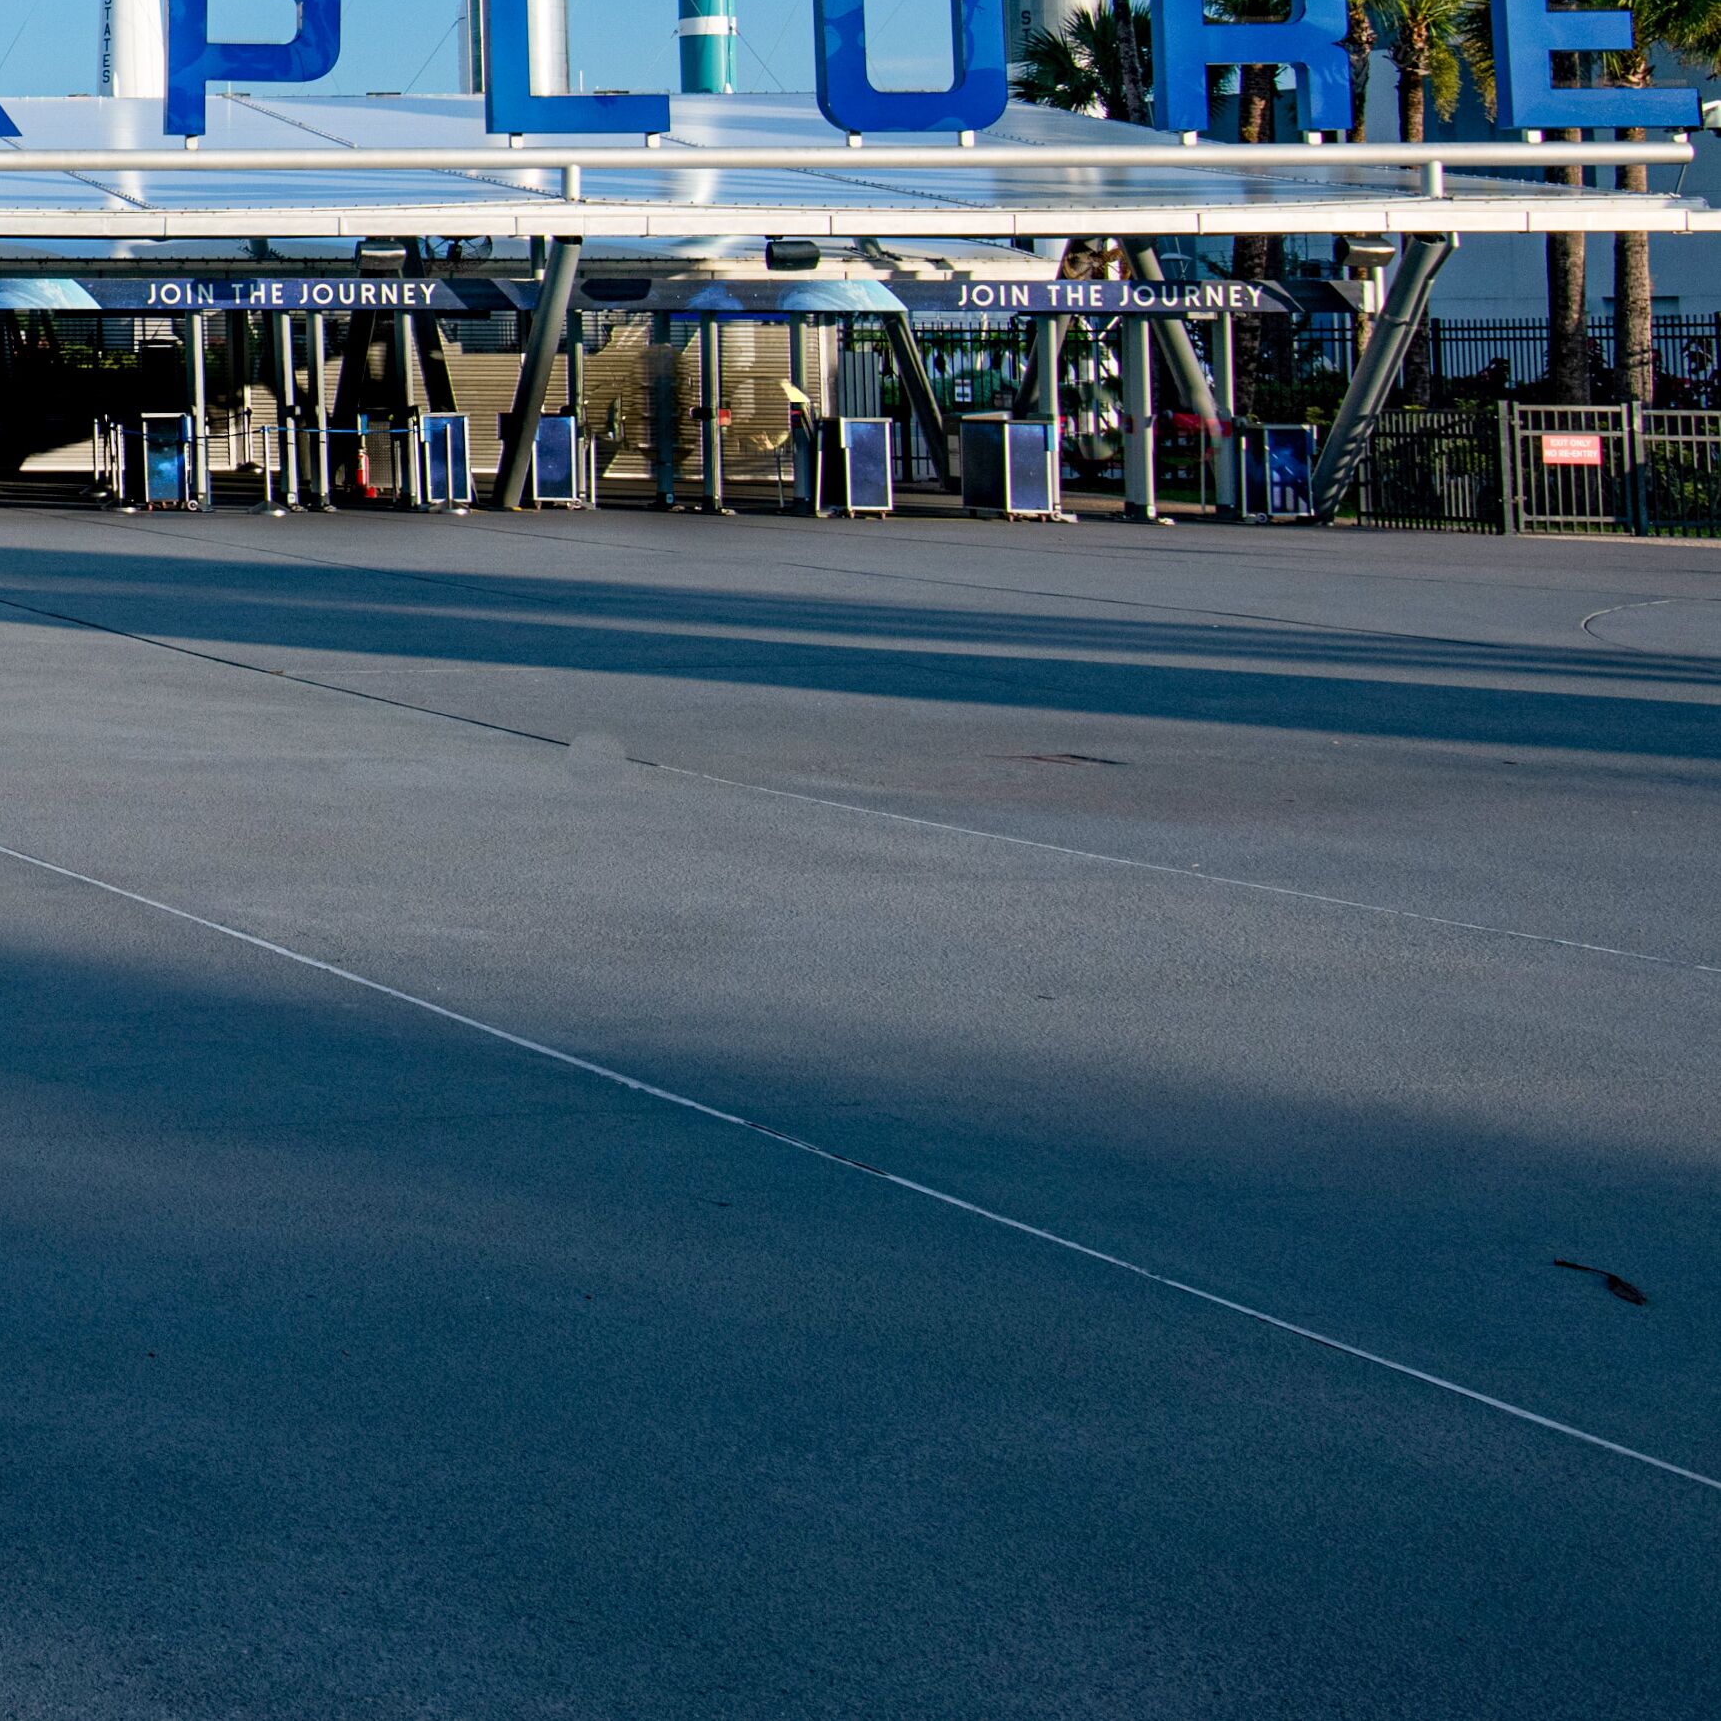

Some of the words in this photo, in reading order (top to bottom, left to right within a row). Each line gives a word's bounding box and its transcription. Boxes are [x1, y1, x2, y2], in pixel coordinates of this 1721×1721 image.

[147, 283, 214, 305] JOIN
[231, 283, 283, 305] THE
[300, 283, 437, 305] JOURNEY
[958, 284, 1029, 307] JOIN
[1047, 284, 1103, 307] THE
[1120, 284, 1263, 308] JOURNEY
[1570, 439, 1592, 447] ONLY
